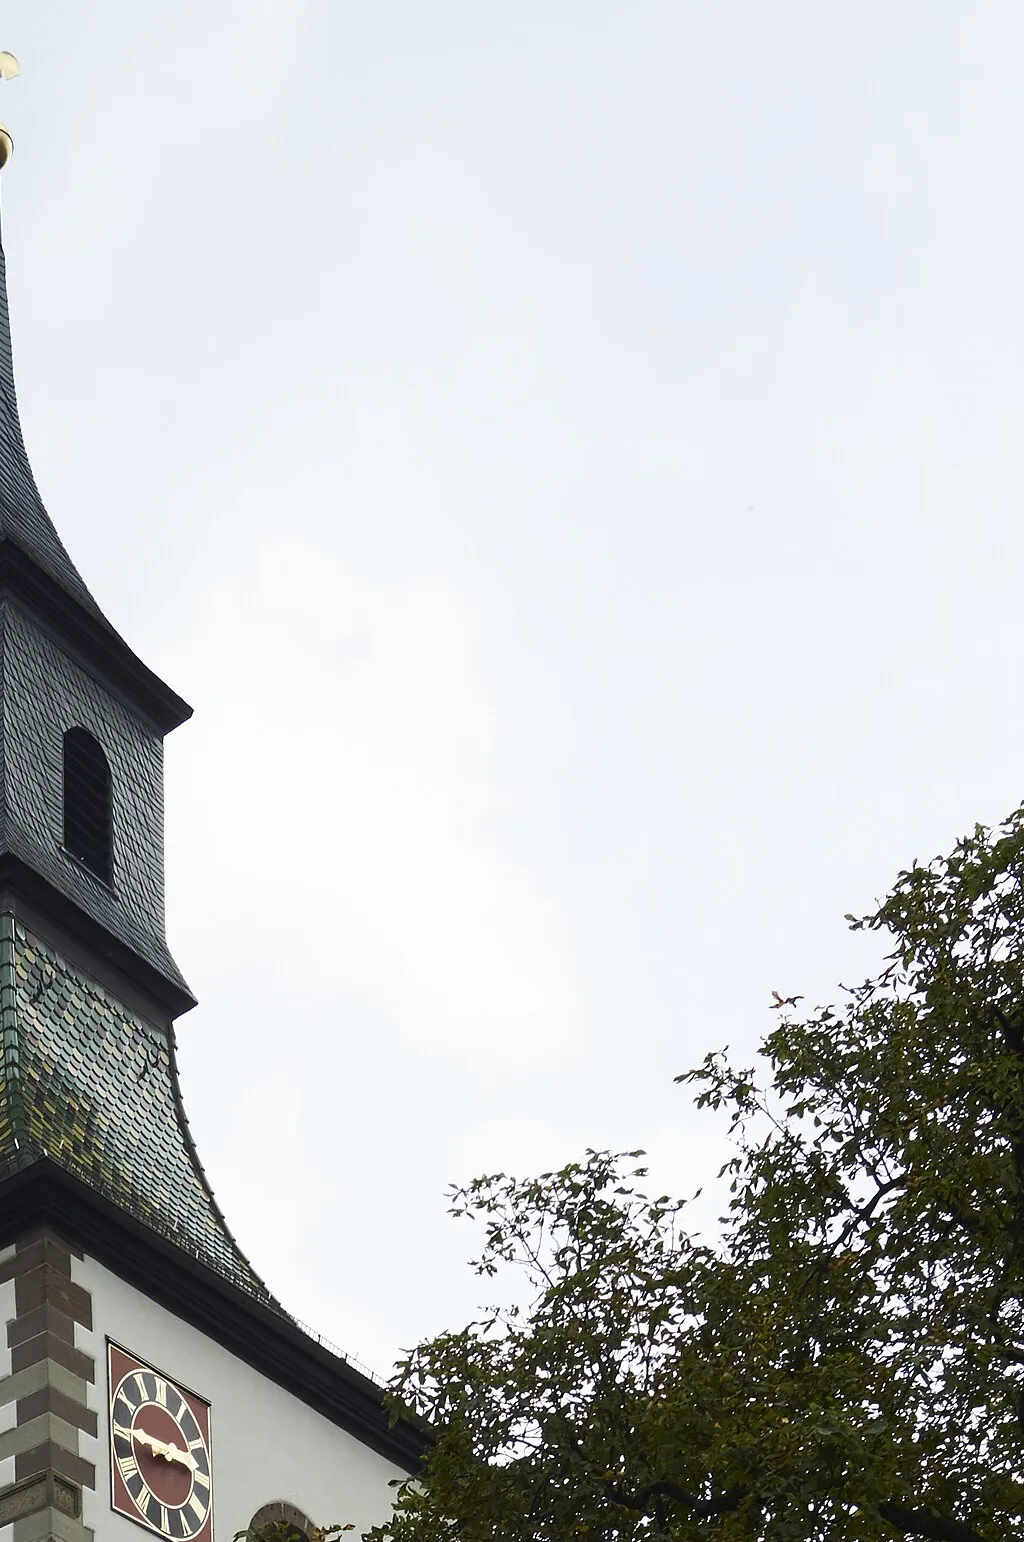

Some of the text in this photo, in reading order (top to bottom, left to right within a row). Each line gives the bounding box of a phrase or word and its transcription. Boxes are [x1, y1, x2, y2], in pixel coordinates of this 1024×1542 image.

[117, 1387, 137, 1416] X
[133, 1373, 150, 1402] XI
[154, 1376, 168, 1408] XII
[175, 1400, 187, 1423] I
[188, 1436, 203, 1451] II
[118, 1458, 137, 1482] VIII
[193, 1471, 210, 1491] III
[136, 1488, 151, 1516] VII
[160, 1505, 171, 1535] VI
[178, 1509, 193, 1537] V
